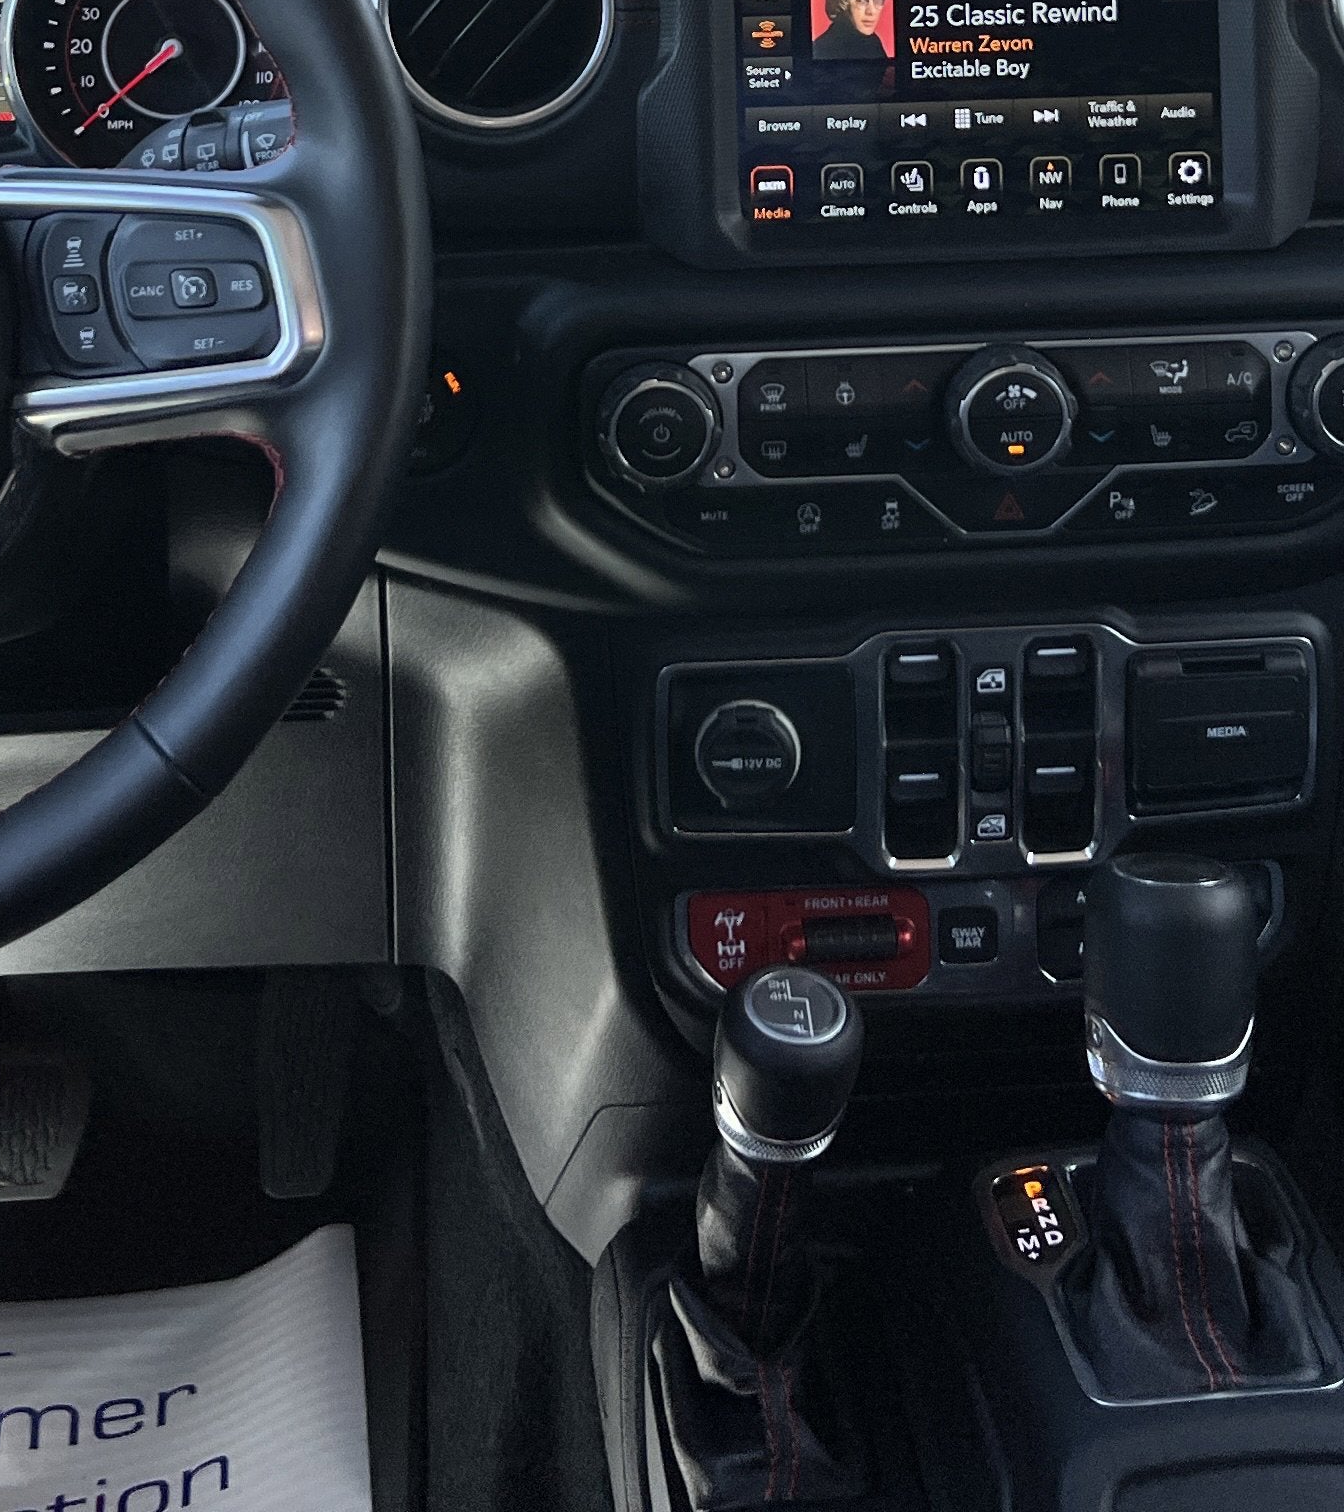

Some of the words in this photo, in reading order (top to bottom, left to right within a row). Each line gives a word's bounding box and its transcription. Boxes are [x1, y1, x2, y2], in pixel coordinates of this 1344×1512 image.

[81, 8, 100, 20] 30
[910, 6, 939, 27] 25
[946, 4, 1025, 27] Classic
[1032, 0, 1117, 24] Rewind
[70, 39, 92, 54] 20
[910, 37, 973, 54] Warren
[978, 35, 1033, 52] Zevon
[746, 66, 781, 78] Source
[911, 60, 990, 79] Excitable
[996, 60, 1030, 79] Boy
[81, 75, 95, 87] 10
[748, 77, 780, 88] Select
[1088, 101, 1124, 115] Traffic
[1161, 106, 1196, 119] Audio
[827, 116, 867, 132] Replay
[974, 112, 1004, 125] Tune
[1087, 114, 1138, 128] Weather
[107, 120, 133, 130] MPH
[759, 119, 801, 132] Browse
[1039, 170, 1063, 184] NW
[829, 181, 855, 190] AUTO
[1039, 197, 1063, 210] Nav
[1102, 195, 1139, 208] Phone
[1167, 192, 1214, 208] Settings
[821, 205, 865, 216] Climate
[889, 201, 938, 214] Controls
[967, 200, 997, 214] Apps
[754, 208, 791, 219] Media
[130, 285, 164, 297] CANC
[231, 280, 253, 291] RES
[1159, 386, 1183, 394] MODE
[1004, 398, 1027, 409] OFF
[1000, 430, 1032, 442] AUTO
[1277, 483, 1314, 493] SCREEN
[1285, 492, 1304, 502] OFF
[701, 512, 728, 520] MUTE
[799, 524, 819, 534] OFF
[881, 519, 900, 529] OFF
[1206, 724, 1246, 738] MEDIA
[805, 897, 845, 909] FRONT
[855, 895, 888, 907] REAR
[952, 927, 985, 938] SWAY
[956, 938, 981, 948] BAR
[719, 959, 744, 969] OFF
[854, 972, 887, 982] ONLY
[770, 992, 787, 1001] 4H
[794, 1010, 803, 1019] N
[1024, 1181, 1042, 1198] P
[1032, 1198, 1050, 1212] R
[1038, 1213, 1058, 1228] N
[1017, 1235, 1040, 1252] M
[1044, 1230, 1064, 1246] D
